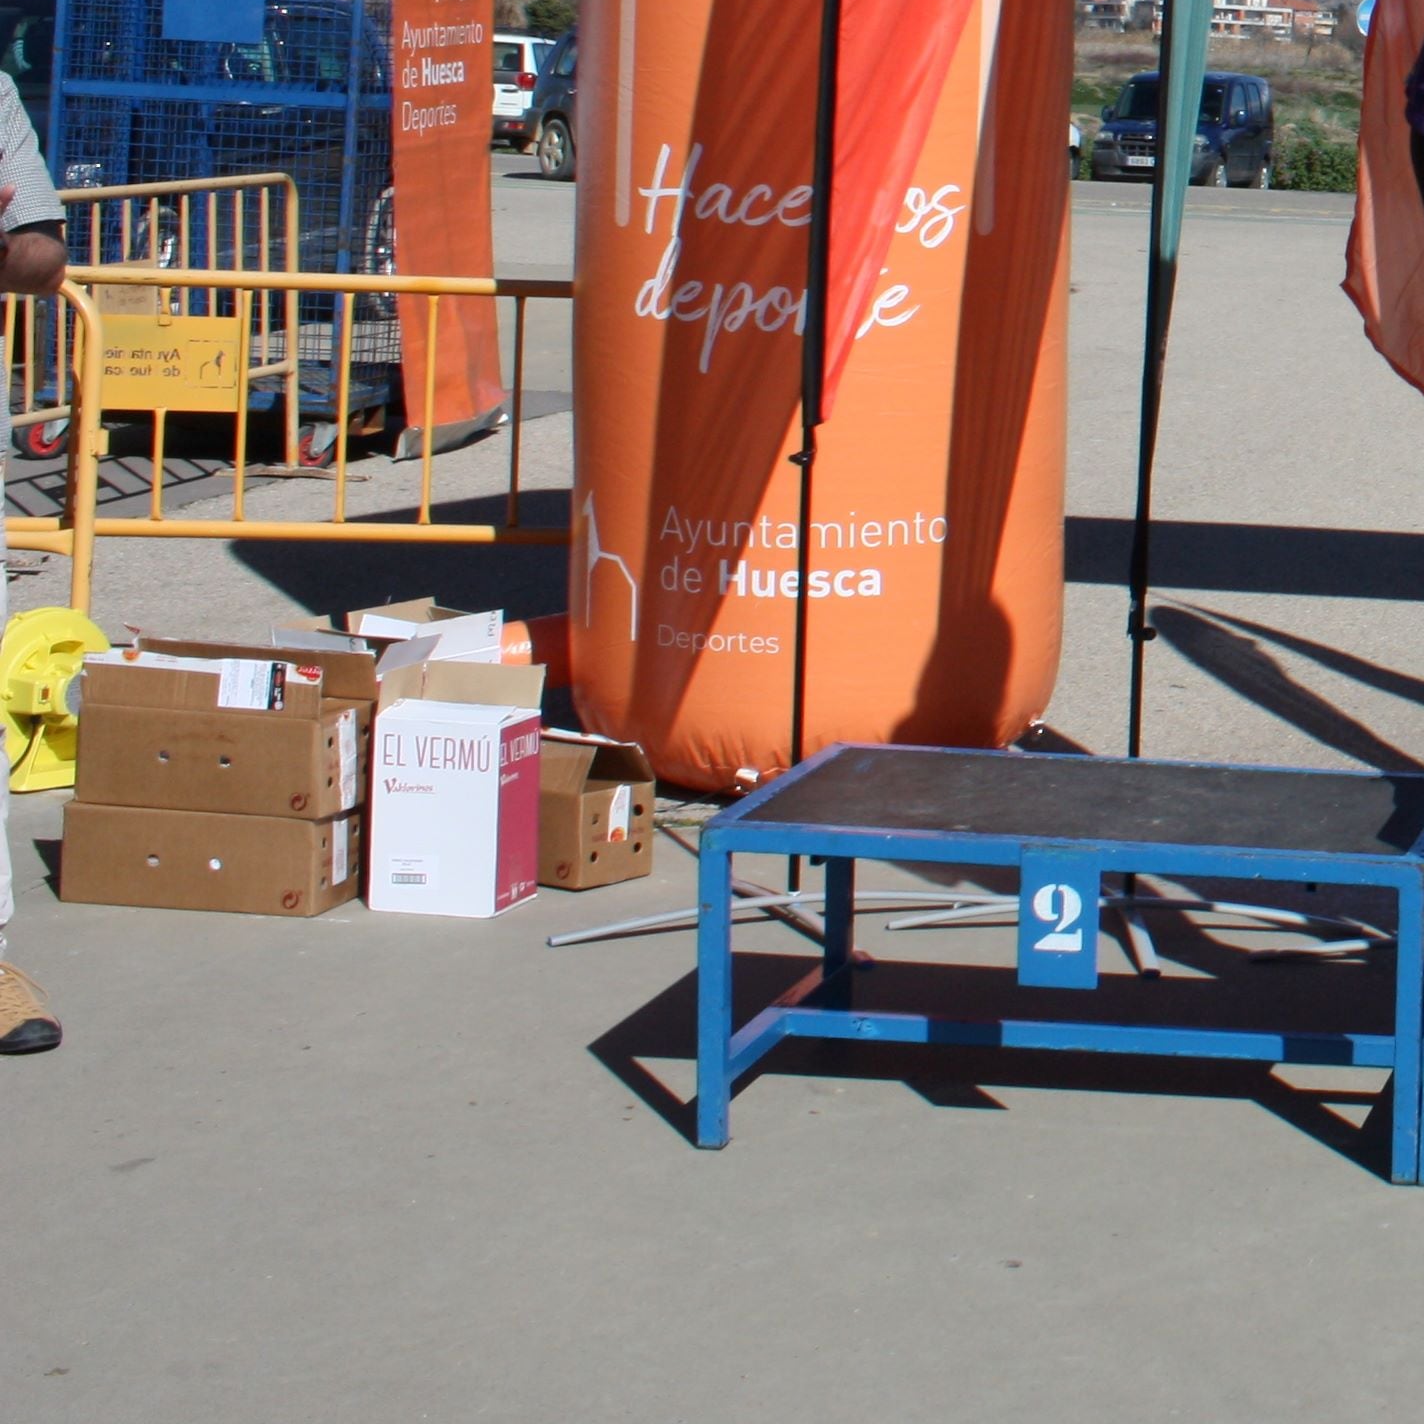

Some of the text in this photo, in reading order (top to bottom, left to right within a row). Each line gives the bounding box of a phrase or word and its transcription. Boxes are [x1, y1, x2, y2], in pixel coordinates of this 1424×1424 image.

[401, 19, 483, 57] Ayuntamiento
[401, 57, 465, 89] de Huesca
[401, 100, 457, 137] Deportes
[637, 142, 967, 249] Haceos
[659, 504, 949, 555] Ayuntamiento
[659, 555, 883, 599] de Huesca
[656, 623, 781, 655] Deportes
[383, 733, 491, 773] EL VERMÚ
[1032, 882, 1084, 952] 2
